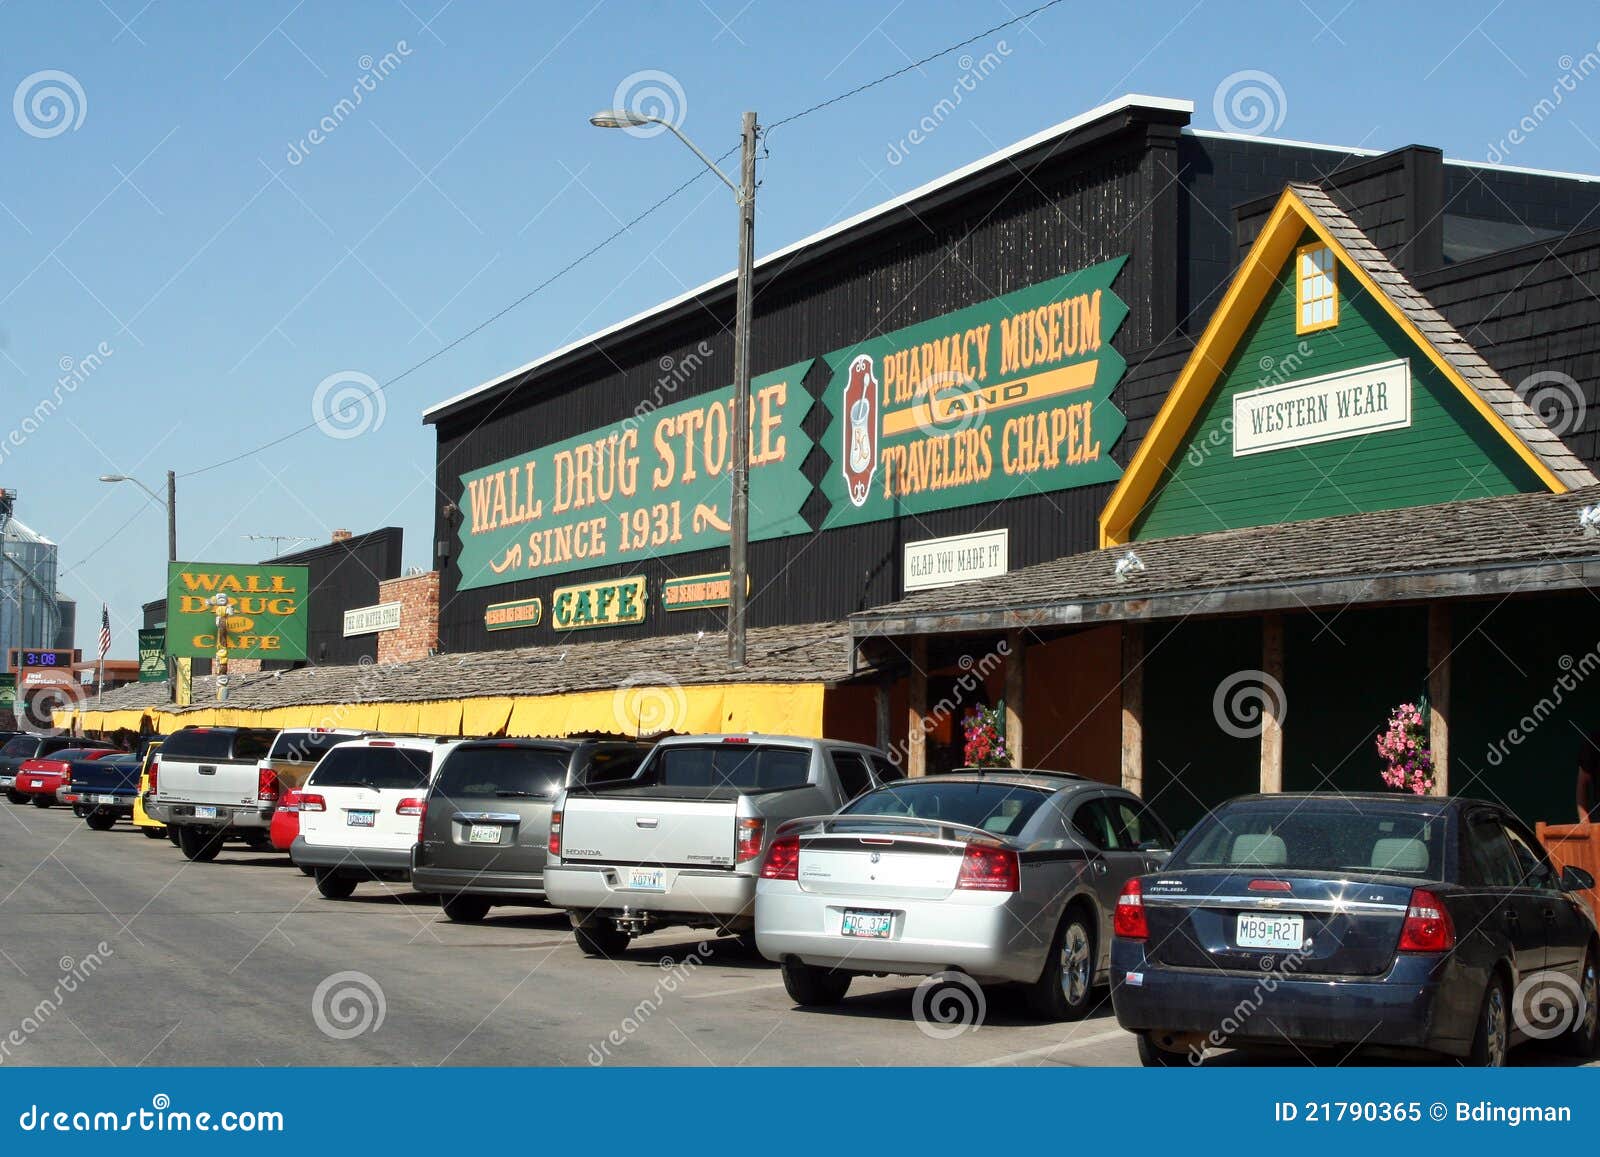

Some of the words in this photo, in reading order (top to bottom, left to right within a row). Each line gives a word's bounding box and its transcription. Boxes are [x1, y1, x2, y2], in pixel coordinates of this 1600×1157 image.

[883, 323, 990, 408] PHARMACY
[1000, 289, 1102, 375] MUSEUM
[947, 382, 1028, 415] AND
[1251, 393, 1328, 435] WESTERN
[1336, 382, 1389, 419] WEAR
[881, 425, 993, 501] TRAVELERS
[1001, 400, 1100, 475] CHAPEL
[468, 461, 542, 535] WALL
[552, 428, 640, 516] DRUG
[528, 516, 607, 568] SINCE
[618, 500, 683, 553] 1931
[911, 554, 934, 577] GLAD
[937, 551, 954, 574] YOU
[957, 546, 985, 572] MADE
[988, 544, 1000, 568] IT
[181, 572, 296, 594] WALL
[555, 582, 639, 626] CAFE
[27, 653, 56, 665] 3:08
[1240, 919, 1267, 939] MB9
[1273, 922, 1300, 941] R2T
